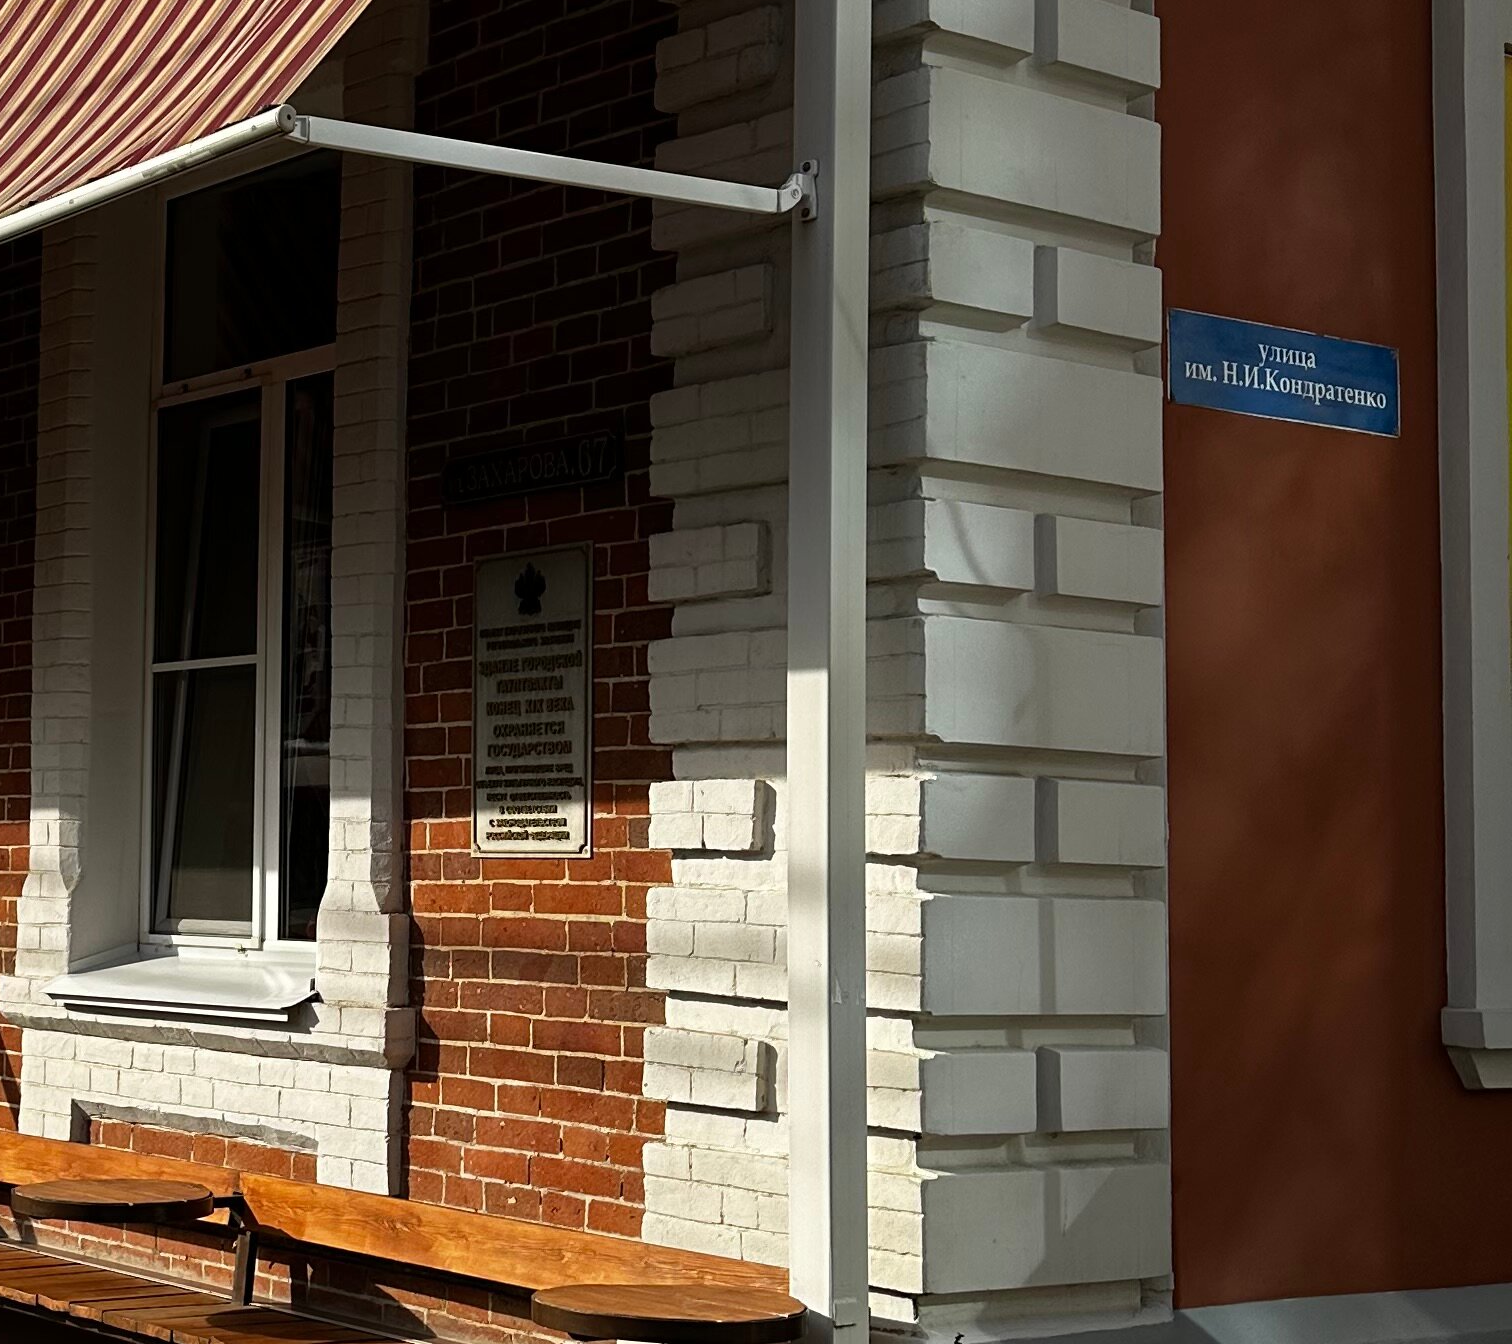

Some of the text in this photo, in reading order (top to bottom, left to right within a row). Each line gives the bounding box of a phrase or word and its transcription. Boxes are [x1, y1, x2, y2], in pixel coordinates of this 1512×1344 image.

[1258, 343, 1317, 370] улица
[1184, 360, 1387, 409] им. Н.И.Кондратенко
[493, 720, 565, 738] ОХРАНЯЕТСЯ
